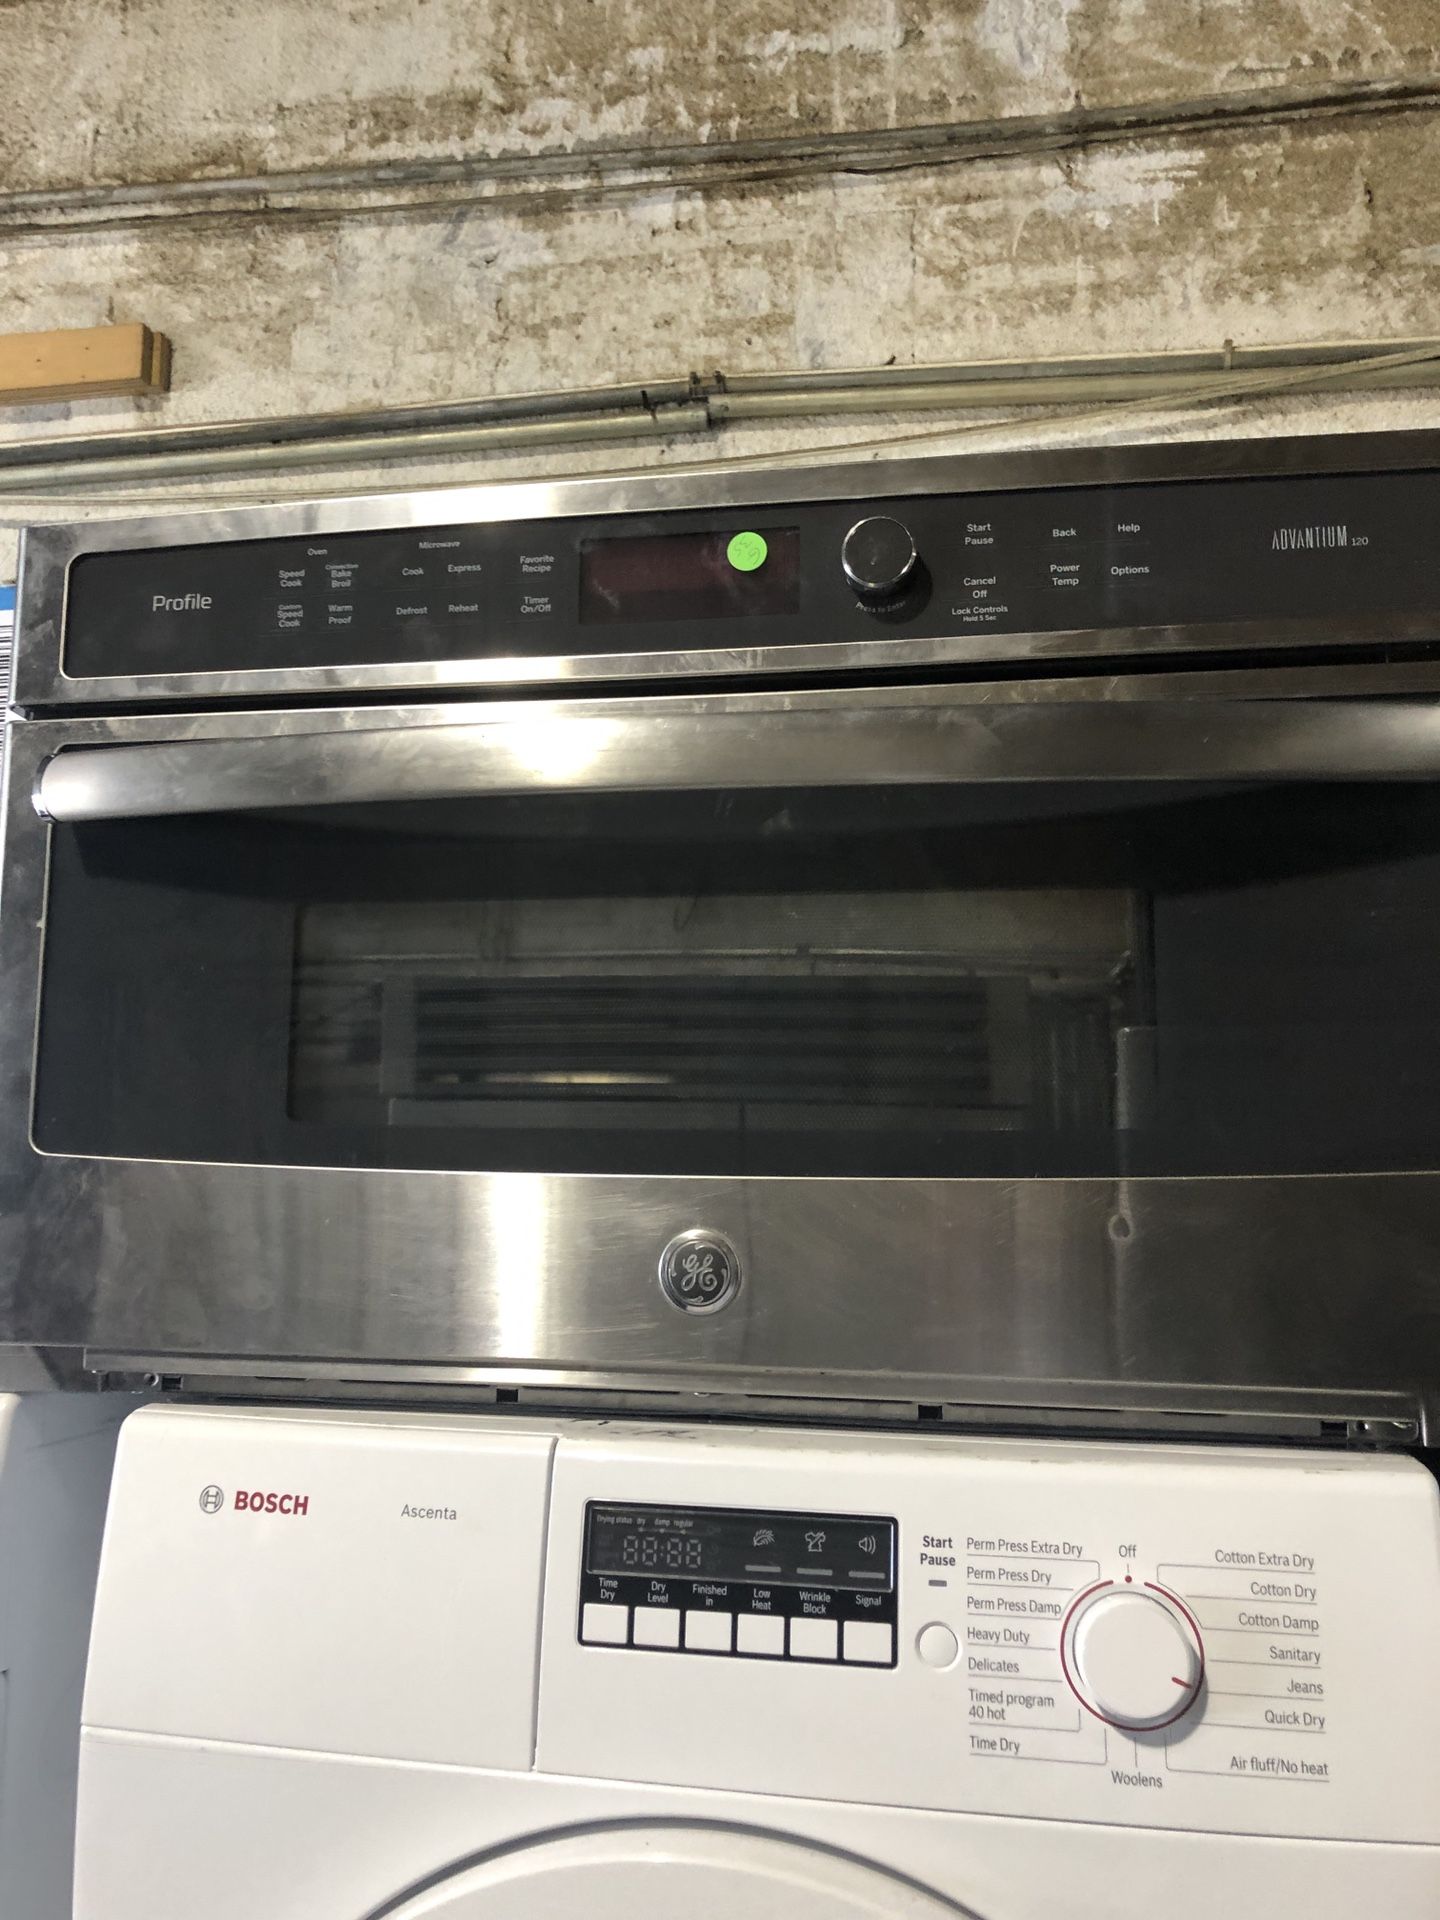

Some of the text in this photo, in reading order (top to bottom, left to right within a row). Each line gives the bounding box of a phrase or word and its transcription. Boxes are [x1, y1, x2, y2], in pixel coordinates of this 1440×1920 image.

[967, 523, 992, 533] Start
[1052, 528, 1077, 537] Back
[1117, 523, 1141, 533] Help
[964, 537, 994, 546] Pause
[1272, 525, 1369, 550] ADVANTIUM 120
[418, 541, 461, 549] Microwave
[307, 548, 328, 556] Oven
[520, 555, 555, 564] Favorite
[278, 569, 306, 579] Speed
[331, 570, 352, 578] Bake
[402, 567, 425, 576] Cook
[447, 564, 482, 573] Express
[522, 564, 551, 574] Recipe
[1050, 564, 1081, 573] Power
[1110, 566, 1150, 576] Options
[280, 579, 303, 588] Cook
[331, 579, 352, 588] Broil
[963, 576, 997, 586] Cancel
[1052, 577, 1080, 587] Temp
[972, 590, 988, 598] Off
[152, 593, 212, 611] Profile
[328, 604, 353, 612] Warm
[396, 606, 428, 616] Defrost
[448, 604, 479, 613] Reheat
[520, 604, 552, 614] On/Off
[951, 605, 1008, 615] Lock Controls
[277, 610, 303, 619] Speed
[278, 619, 301, 628] Cook
[328, 616, 352, 625] Proof
[234, 1490, 309, 1516] BOSCH
[400, 1504, 457, 1520] Ascenta
[922, 1535, 953, 1549] Start
[966, 1537, 1083, 1558] Perm Press Extra Dry
[1118, 1544, 1137, 1558] Off
[920, 1553, 956, 1566] Pause
[1214, 1549, 1315, 1571] Cotton Extra Dry
[966, 1566, 1052, 1584] Perm Press Dry
[598, 1577, 619, 1588] Time
[651, 1580, 666, 1593] Dry
[600, 1589, 615, 1600] Dry
[692, 1583, 728, 1596] Finished
[753, 1588, 771, 1599] Low
[1250, 1581, 1317, 1602] Cotton Dry
[647, 1592, 669, 1603] Level
[705, 1597, 714, 1606] in
[799, 1591, 831, 1603] Wrinkle
[855, 1595, 882, 1608] Signal
[751, 1600, 772, 1611] Heat
[803, 1603, 827, 1615] Block
[966, 1596, 1062, 1615] Perm Press Damp
[1238, 1612, 1320, 1632] Cotton Damp
[967, 1627, 1030, 1644] Heavy Duty
[1269, 1645, 1321, 1665] Sanitary
[967, 1657, 1020, 1673] Delicates
[1286, 1678, 1324, 1695] Jeans
[968, 1688, 1055, 1708] Timed program
[968, 1705, 1007, 1721] 40 hot
[1264, 1709, 1326, 1729] Quick Dry
[969, 1735, 1020, 1755] Time Dry
[1230, 1755, 1329, 1776] Air fluff/No heat
[1111, 1770, 1163, 1789] Woolens
